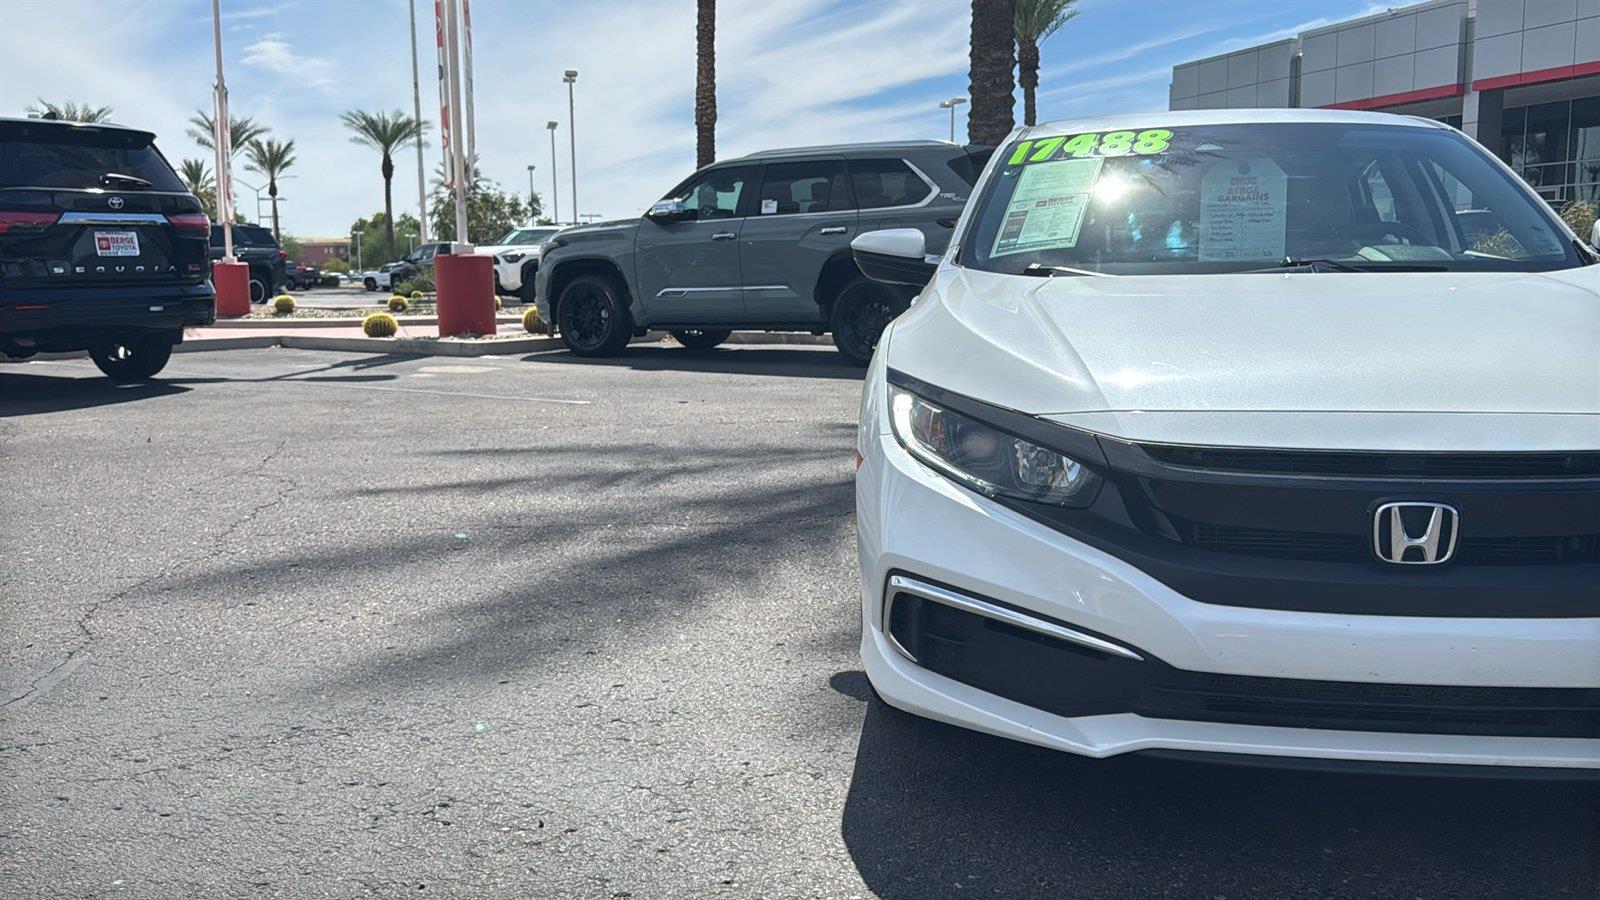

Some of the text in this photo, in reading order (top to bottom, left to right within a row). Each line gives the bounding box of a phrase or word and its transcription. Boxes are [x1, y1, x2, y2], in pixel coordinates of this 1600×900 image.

[1008, 129, 1173, 165] 17488
[1227, 186, 1260, 195] BERGE
[1217, 191, 1270, 202] BARGAINS
[53, 265, 177, 274] SEQUOIA
